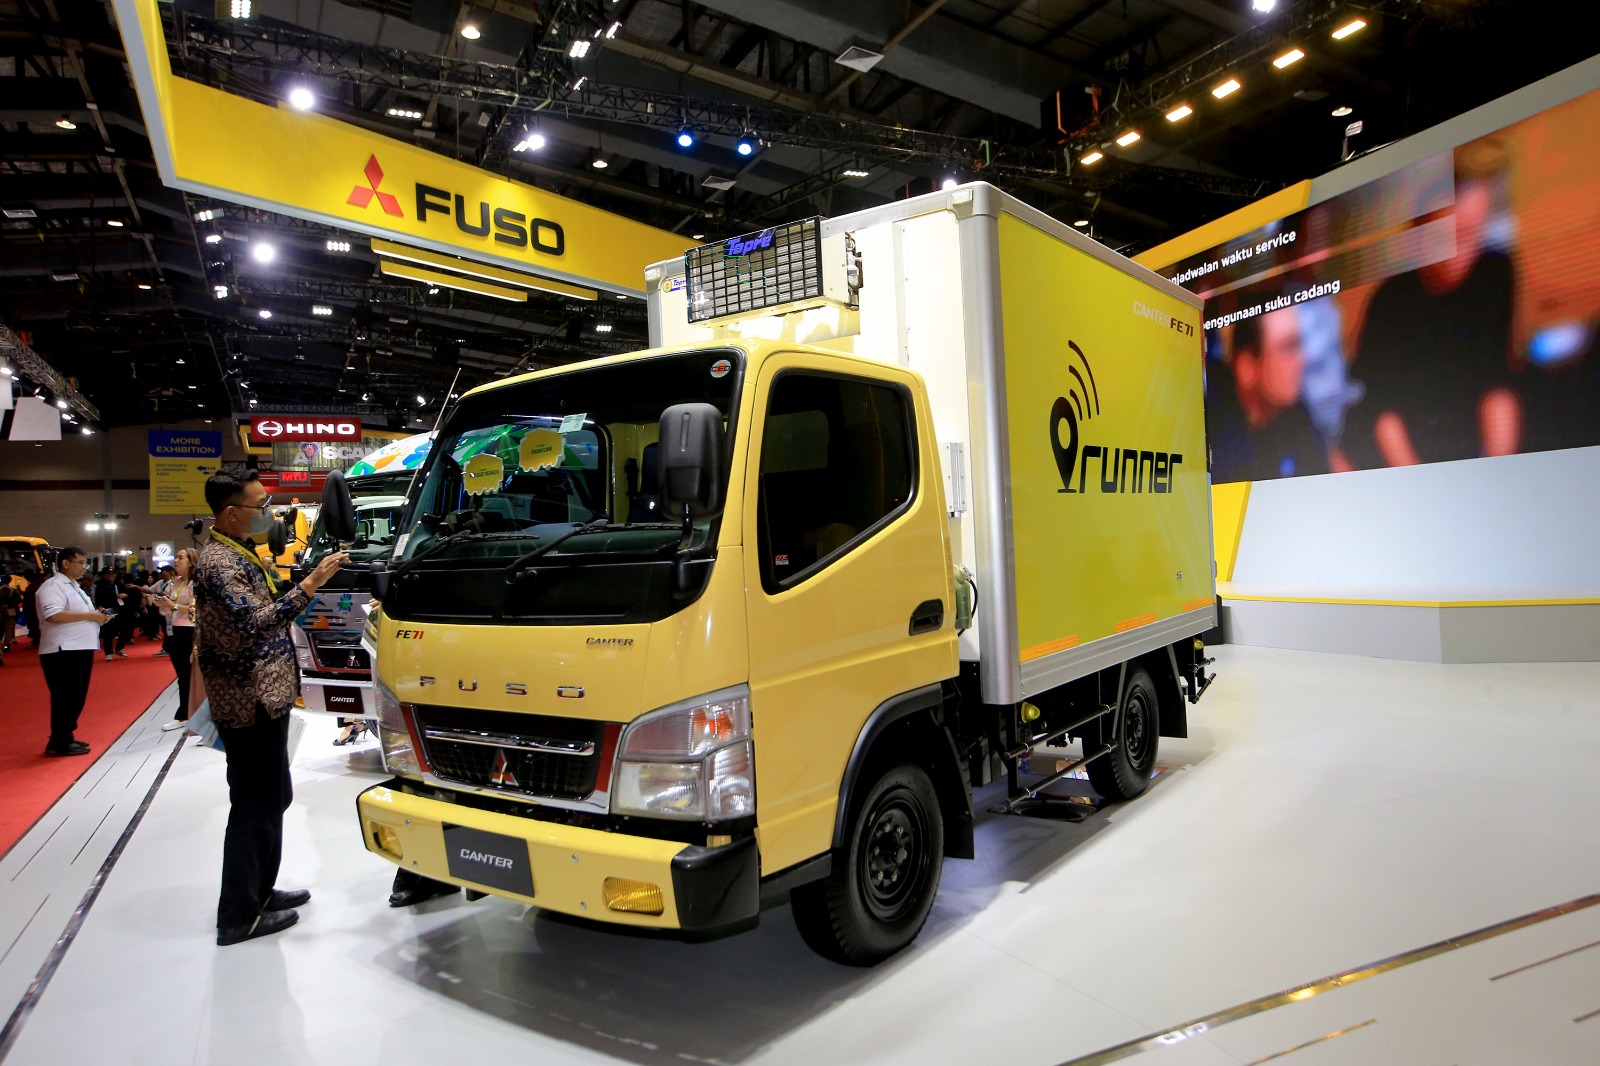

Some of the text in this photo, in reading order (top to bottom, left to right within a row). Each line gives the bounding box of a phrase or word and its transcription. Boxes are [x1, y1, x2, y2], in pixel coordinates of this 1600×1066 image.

[415, 182, 565, 256] FUSO
[727, 234, 772, 256] Topre
[1221, 247, 1253, 267] waktu
[1255, 230, 1296, 255] service
[1264, 294, 1291, 312] suku
[1294, 278, 1341, 303] cadang
[286, 423, 356, 435] HINO
[156, 445, 216, 454] EXHIBITION
[170, 437, 201, 445] MORE
[281, 472, 308, 482] MTU
[1079, 445, 1183, 494] runner
[396, 629, 424, 640] FE71
[585, 637, 634, 647] CANTER
[419, 675, 586, 699] FUSO
[460, 848, 514, 869] CANTER
